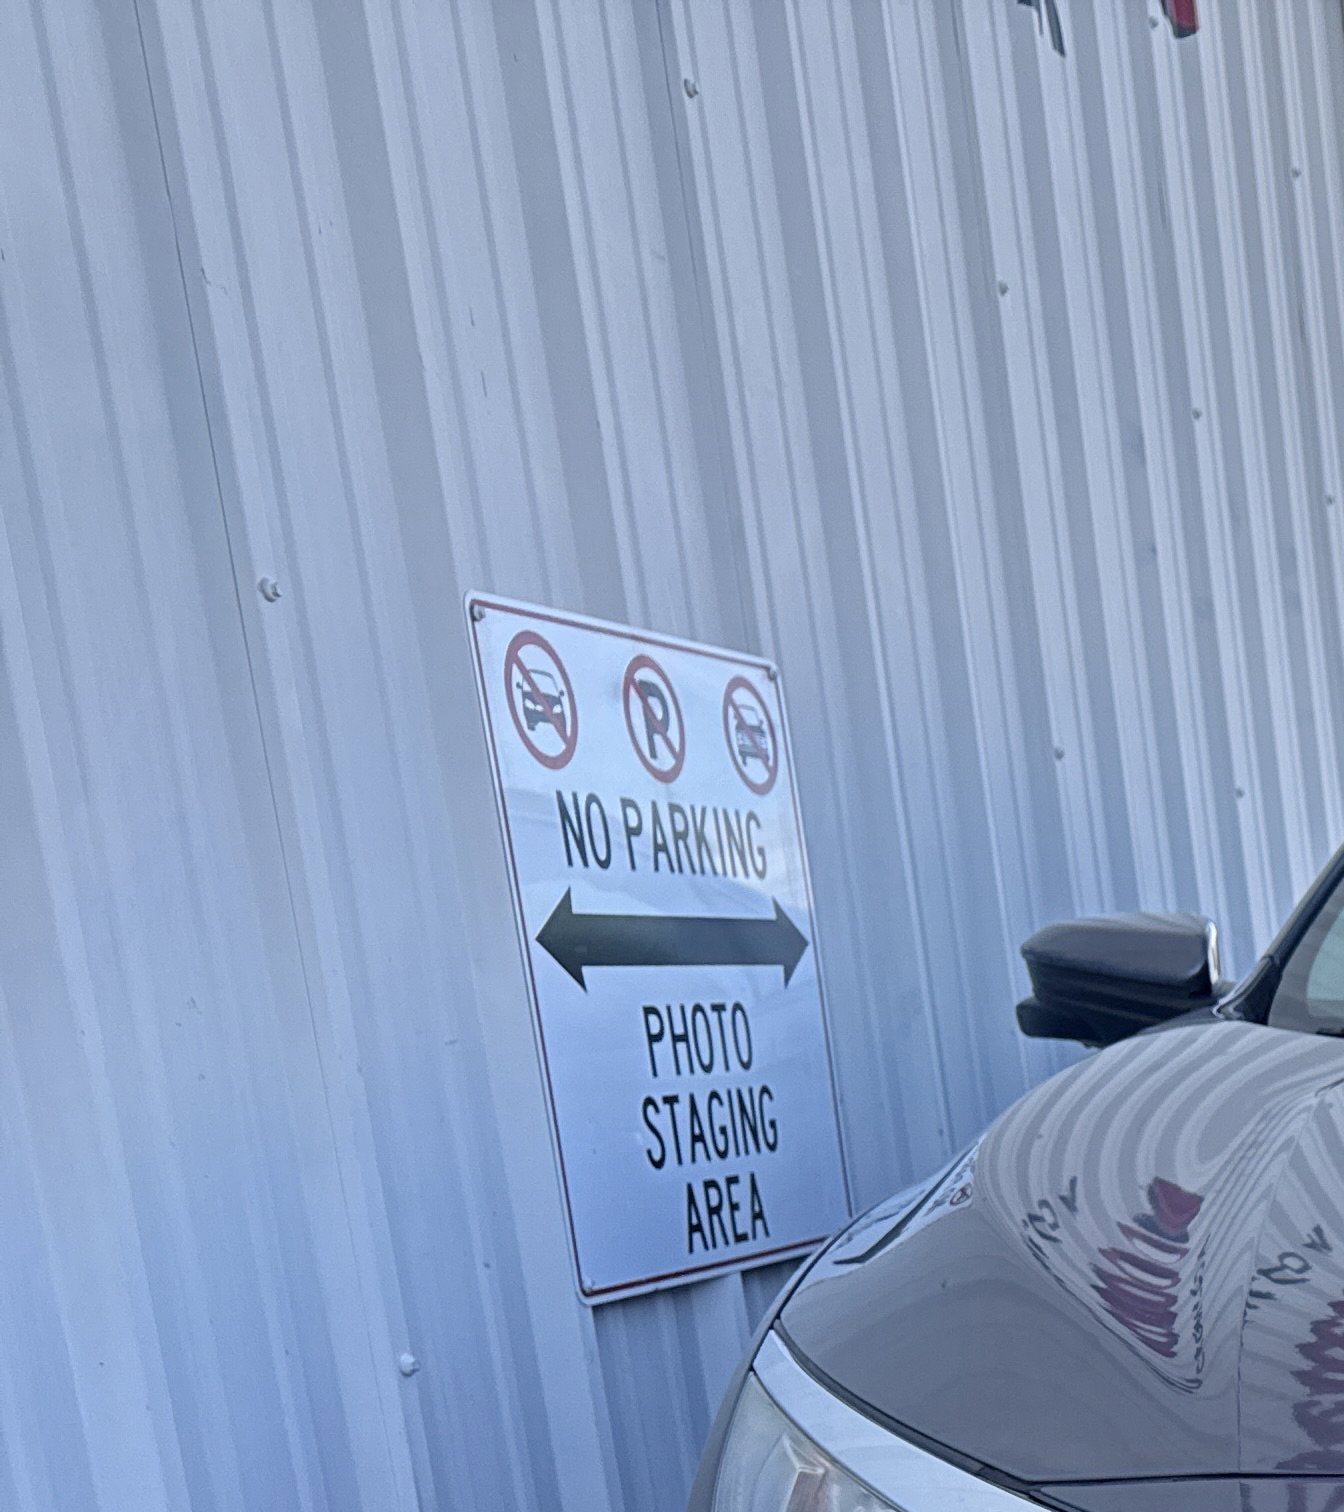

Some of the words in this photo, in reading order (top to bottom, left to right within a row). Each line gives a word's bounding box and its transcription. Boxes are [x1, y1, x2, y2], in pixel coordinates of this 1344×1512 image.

[555, 789, 612, 870] NO
[619, 797, 767, 881] PARKING
[641, 1000, 753, 1078] PHOTO
[641, 1084, 778, 1170] STAGING
[686, 1171, 771, 1255] AREA
